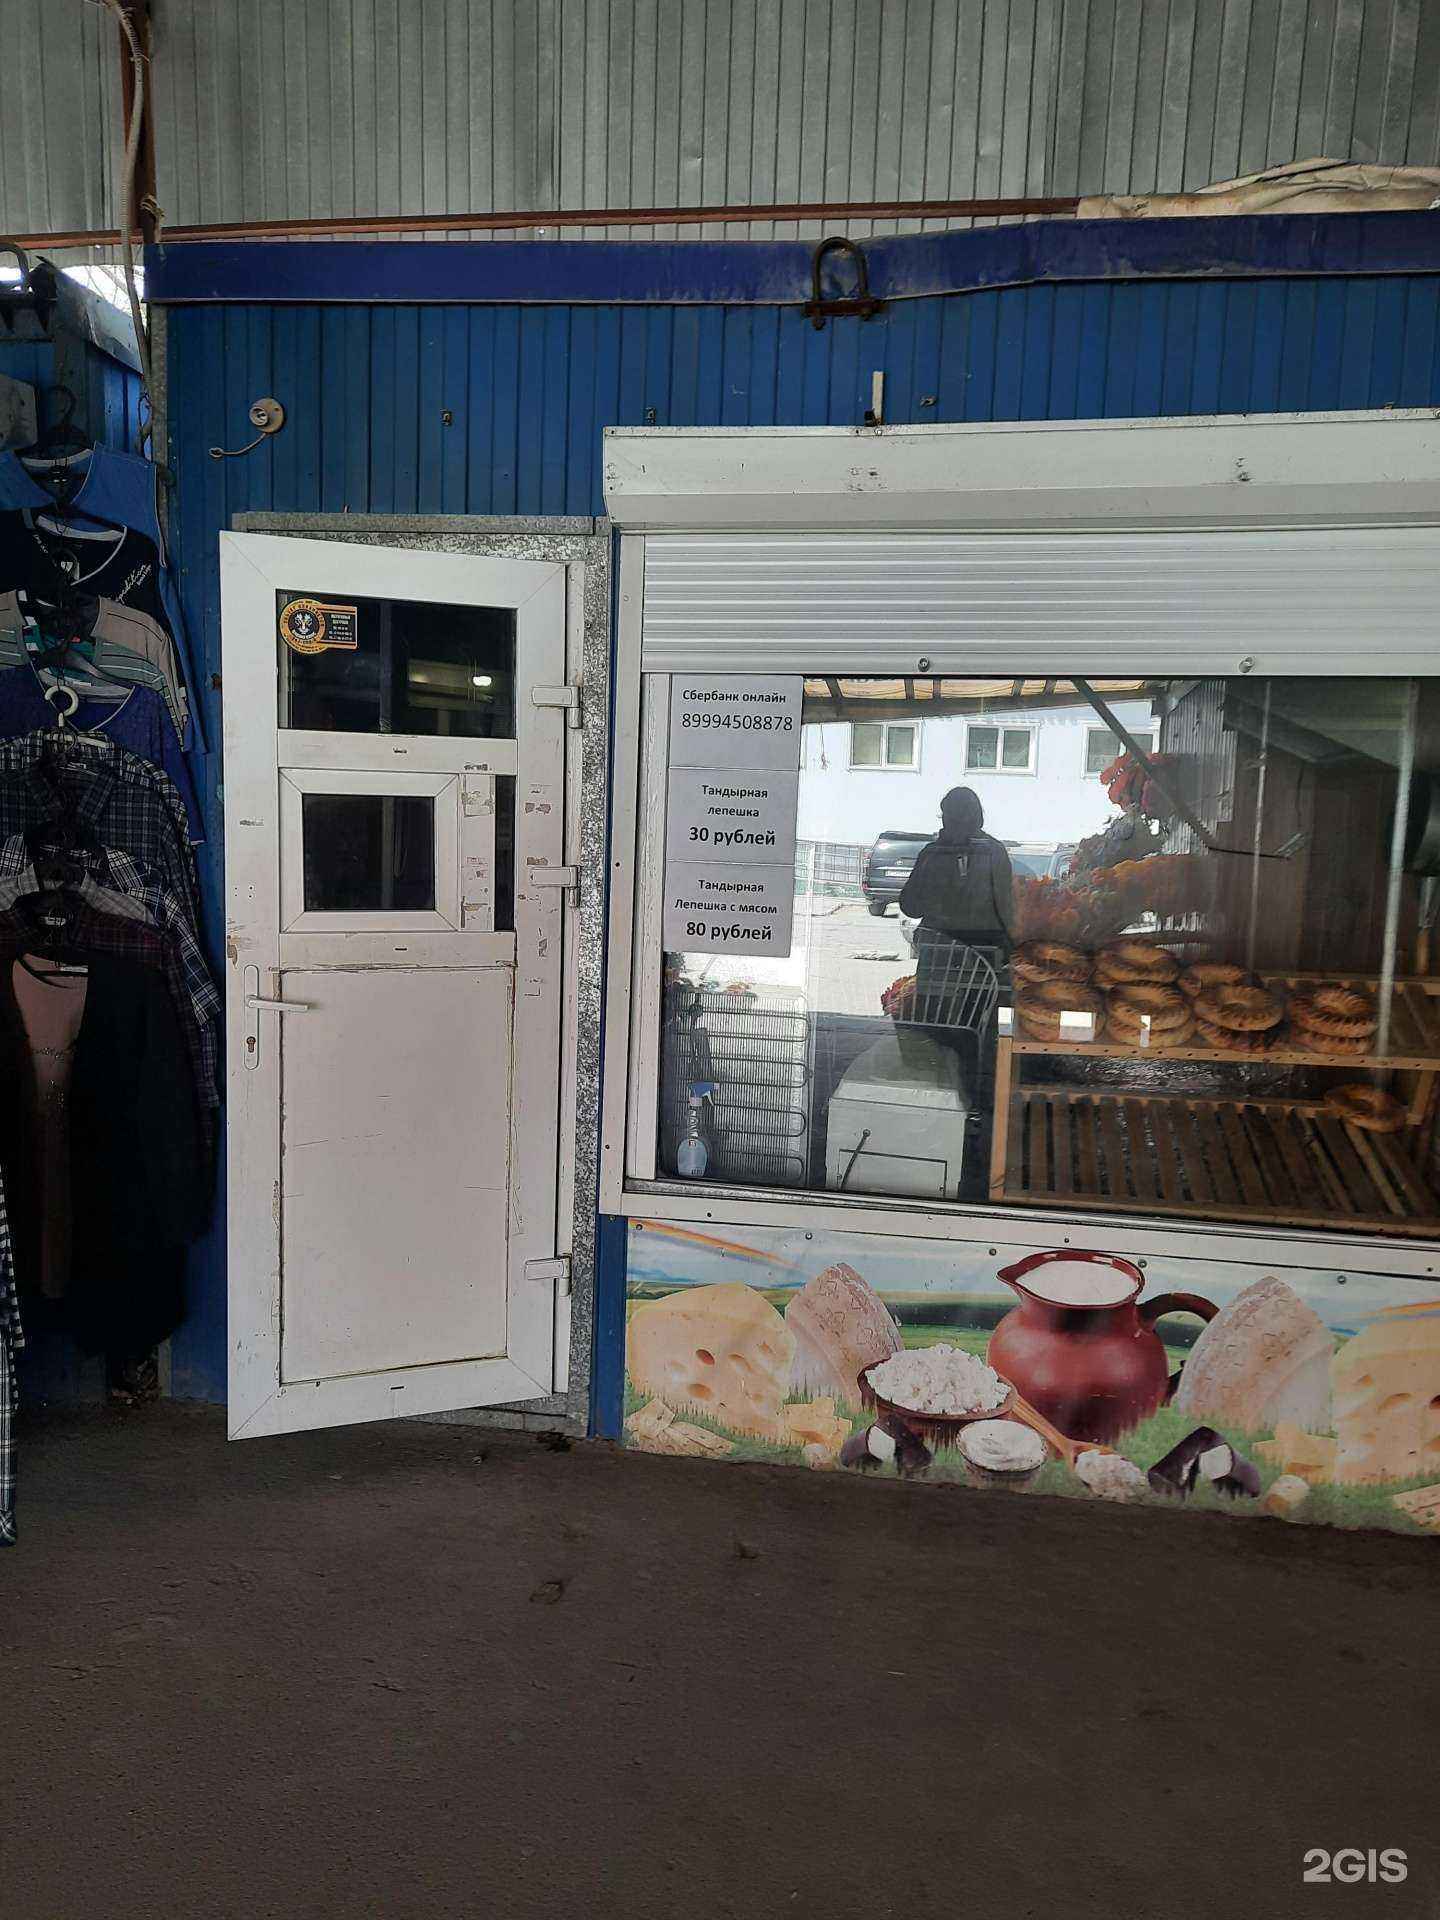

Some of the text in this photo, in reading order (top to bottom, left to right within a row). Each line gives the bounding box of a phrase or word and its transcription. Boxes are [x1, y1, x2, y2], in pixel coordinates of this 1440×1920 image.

[682, 689, 787, 704] Сбербанк онлайн
[682, 712, 793, 732] 89994508878
[702, 784, 768, 799] Тандырная
[707, 806, 760, 818] лепешка
[689, 826, 776, 847] 30 рублей
[698, 879, 764, 894] Тандырная
[675, 898, 778, 914] Лепешка с мясом
[686, 921, 772, 942] 80 рублей
